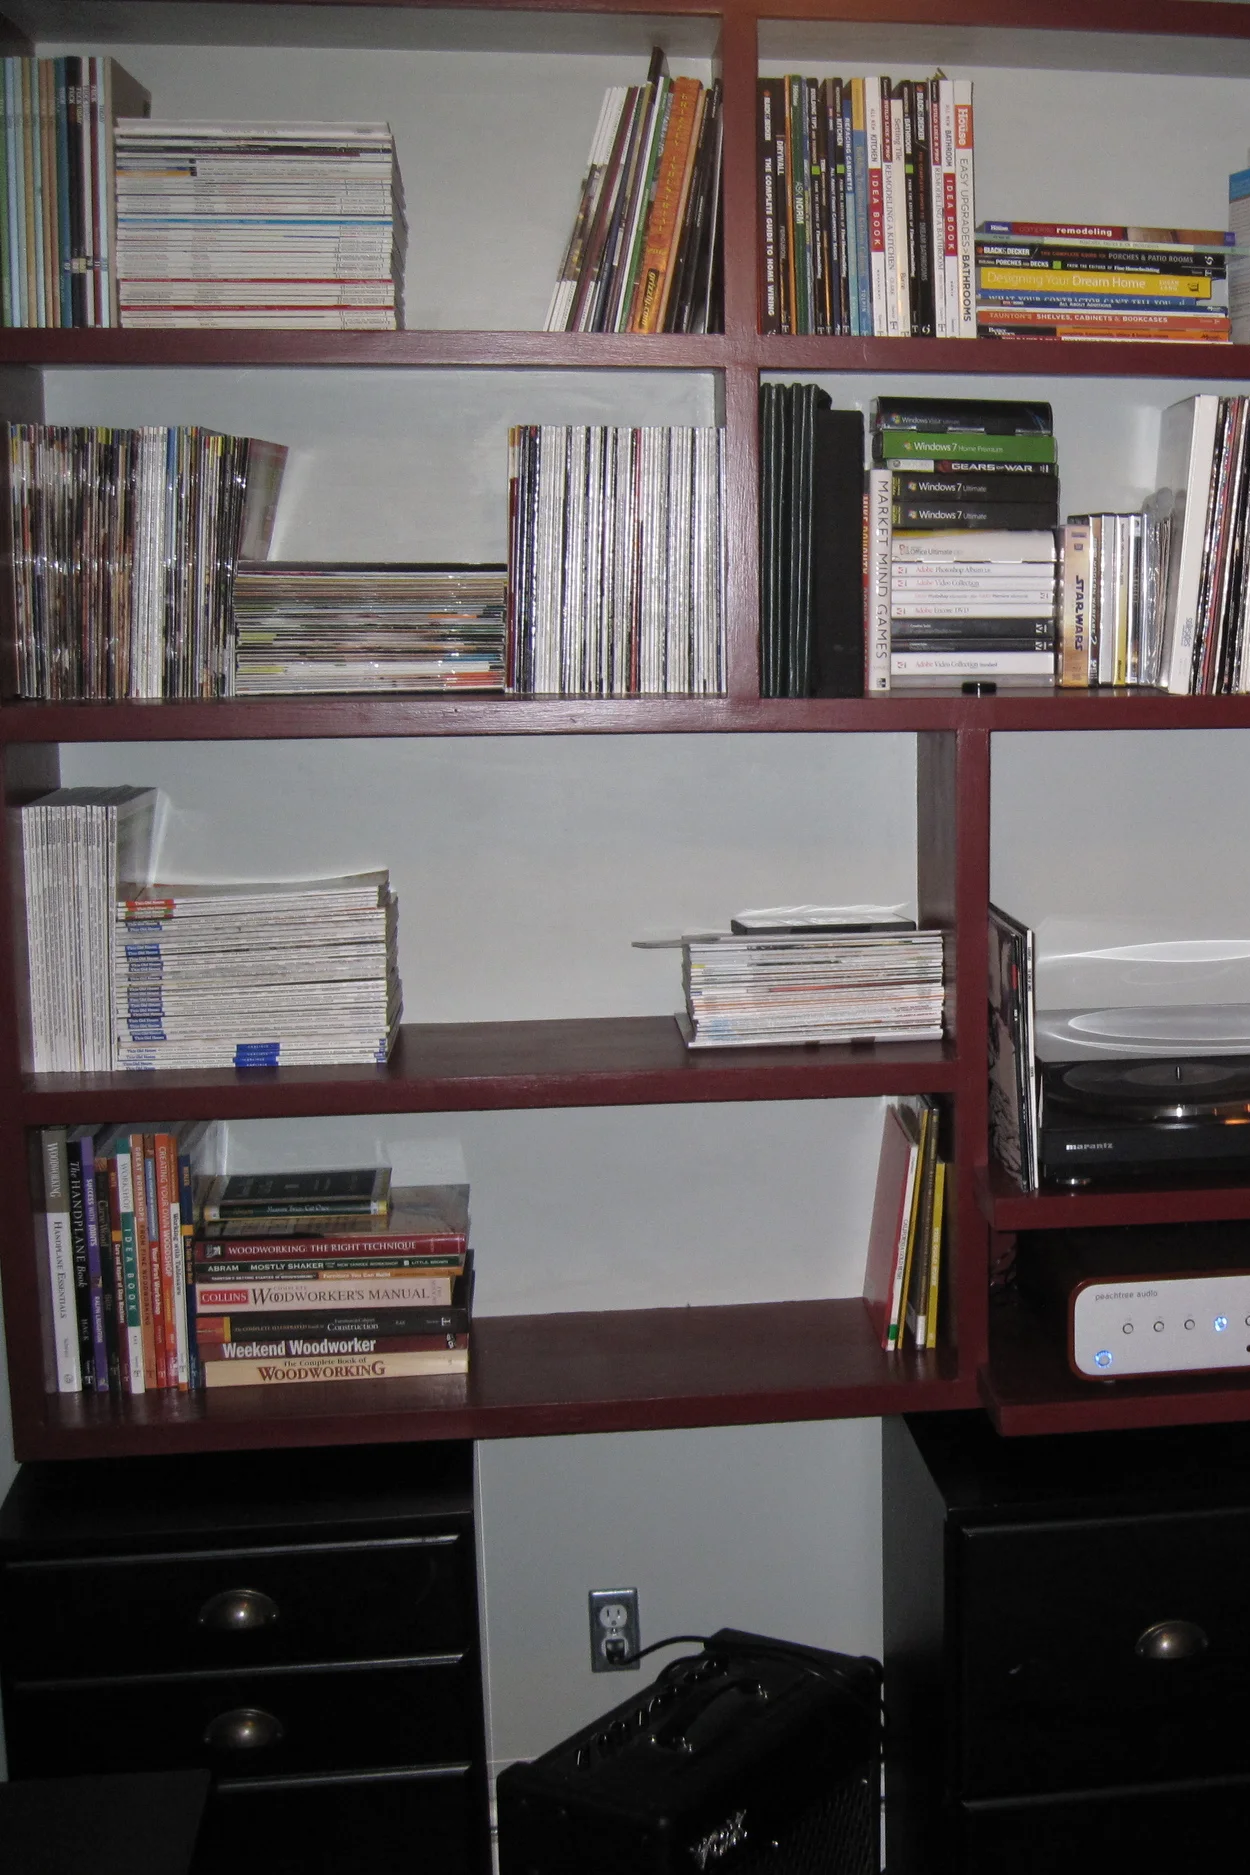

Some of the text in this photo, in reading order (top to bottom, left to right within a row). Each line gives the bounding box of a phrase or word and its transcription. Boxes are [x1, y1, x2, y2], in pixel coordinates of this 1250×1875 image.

[765, 175, 773, 215] COMPLETE
[885, 164, 893, 223] REMODELING
[935, 167, 943, 219] REMODELING
[796, 197, 804, 224] NORM
[958, 108, 971, 322] House EASY UPGRADES BATHROOMS
[1056, 227, 1112, 237] remodeling
[767, 246, 773, 256] TO
[987, 272, 1146, 289] Designing Your Dream Home
[643, 272, 656, 326] grizzly.com
[767, 285, 775, 316] WIRING
[914, 442, 951, 451] Windows
[951, 443, 957, 451] 7
[951, 463, 996, 471] GEARS
[918, 482, 956, 491] Windows
[957, 483, 962, 491] 7
[919, 510, 956, 519] Windows
[957, 511, 962, 519] 7
[876, 480, 888, 659] MARKET MIND GAMES
[935, 567, 963, 575] Photoshop
[1075, 575, 1084, 651] STAR WARS
[1091, 635, 1097, 645] 2
[951, 661, 979, 669] Collection
[1065, 1142, 1113, 1151] marantz
[134, 1146, 142, 1173] GREAT
[136, 1174, 144, 1222] WORKSHOPS
[158, 1146, 172, 1277] CREATING YOUR OWN WOODSHOP
[46, 1142, 67, 1319] WOODWORKING HANDPLANE ESSENTIALS
[120, 1162, 136, 1311] WORKSHOP IDEA BOOK
[139, 1225, 147, 1245] FROM
[172, 1213, 180, 1241] Working
[70, 1161, 90, 1341] The HANDPLANE Book HACK
[86, 1179, 102, 1312] SUCCESS WITH JOINTS RALPH
[228, 1241, 417, 1256] WOODWORKING: THE RIGHT TECHNIQUE
[250, 1263, 286, 1271] MOSTLY
[287, 1262, 324, 1270] SHAKER
[897, 1250, 906, 1265] GOLD
[150, 1247, 162, 1315] Your First Workshop
[175, 1260, 183, 1296] Tablesaws
[141, 1269, 151, 1326] WOODWORKING
[201, 1288, 430, 1305] COLLINS WOODWORKER'S MANUAL
[1094, 1290, 1159, 1301] peachtree audio
[327, 1322, 380, 1331] Construction
[222, 1338, 377, 1358] Weekend Woodworker
[257, 1360, 386, 1382] WOODWORKING
[298, 1358, 336, 1368] Complete
[359, 1356, 367, 1364] of
